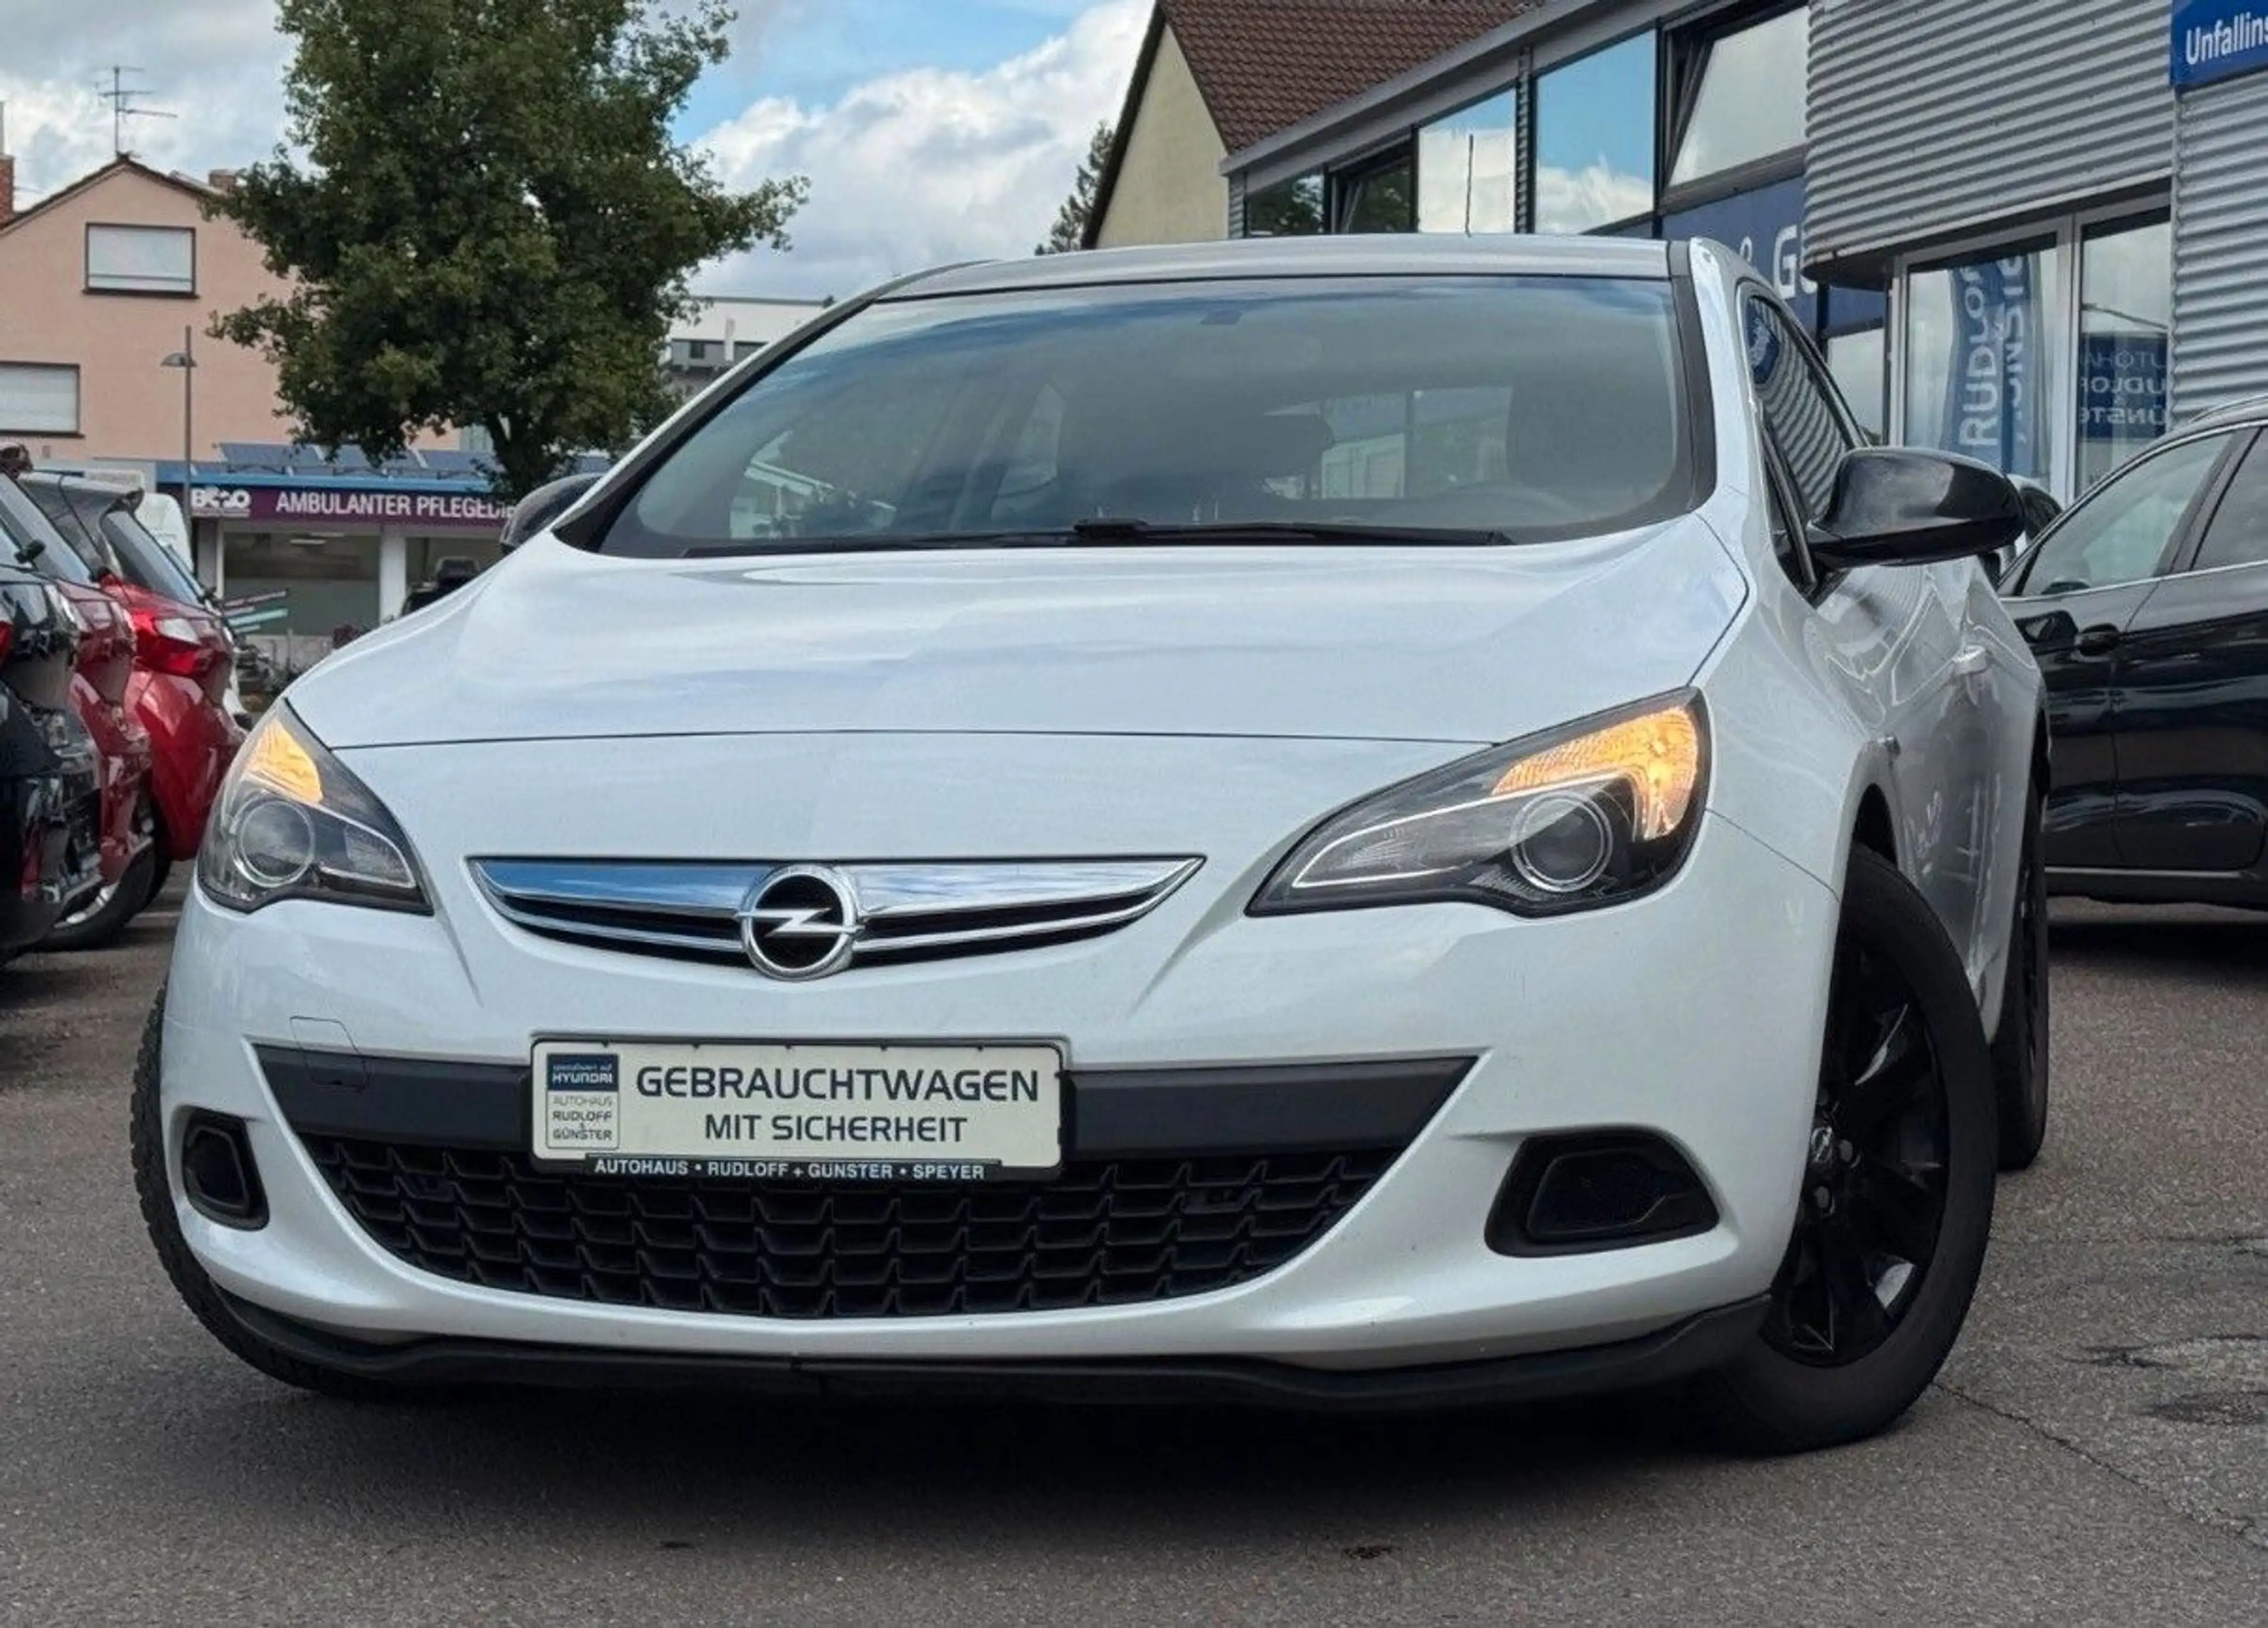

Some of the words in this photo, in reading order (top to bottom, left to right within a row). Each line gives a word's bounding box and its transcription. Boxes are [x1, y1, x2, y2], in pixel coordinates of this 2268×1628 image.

[275, 491, 411, 516] AMBULANTER
[553, 1072, 612, 1084] HYUNDAI
[637, 1066, 1038, 1102] GEBRAUCHTWAGEN
[553, 1110, 612, 1122] RUDLOFF
[705, 1114, 762, 1140] MIT
[771, 1115, 967, 1143] SICHERHEIT
[594, 1159, 689, 1175] AUTOHAUS
[708, 1161, 788, 1177] RUDLOFF
[913, 1164, 985, 1180] SPEYER
